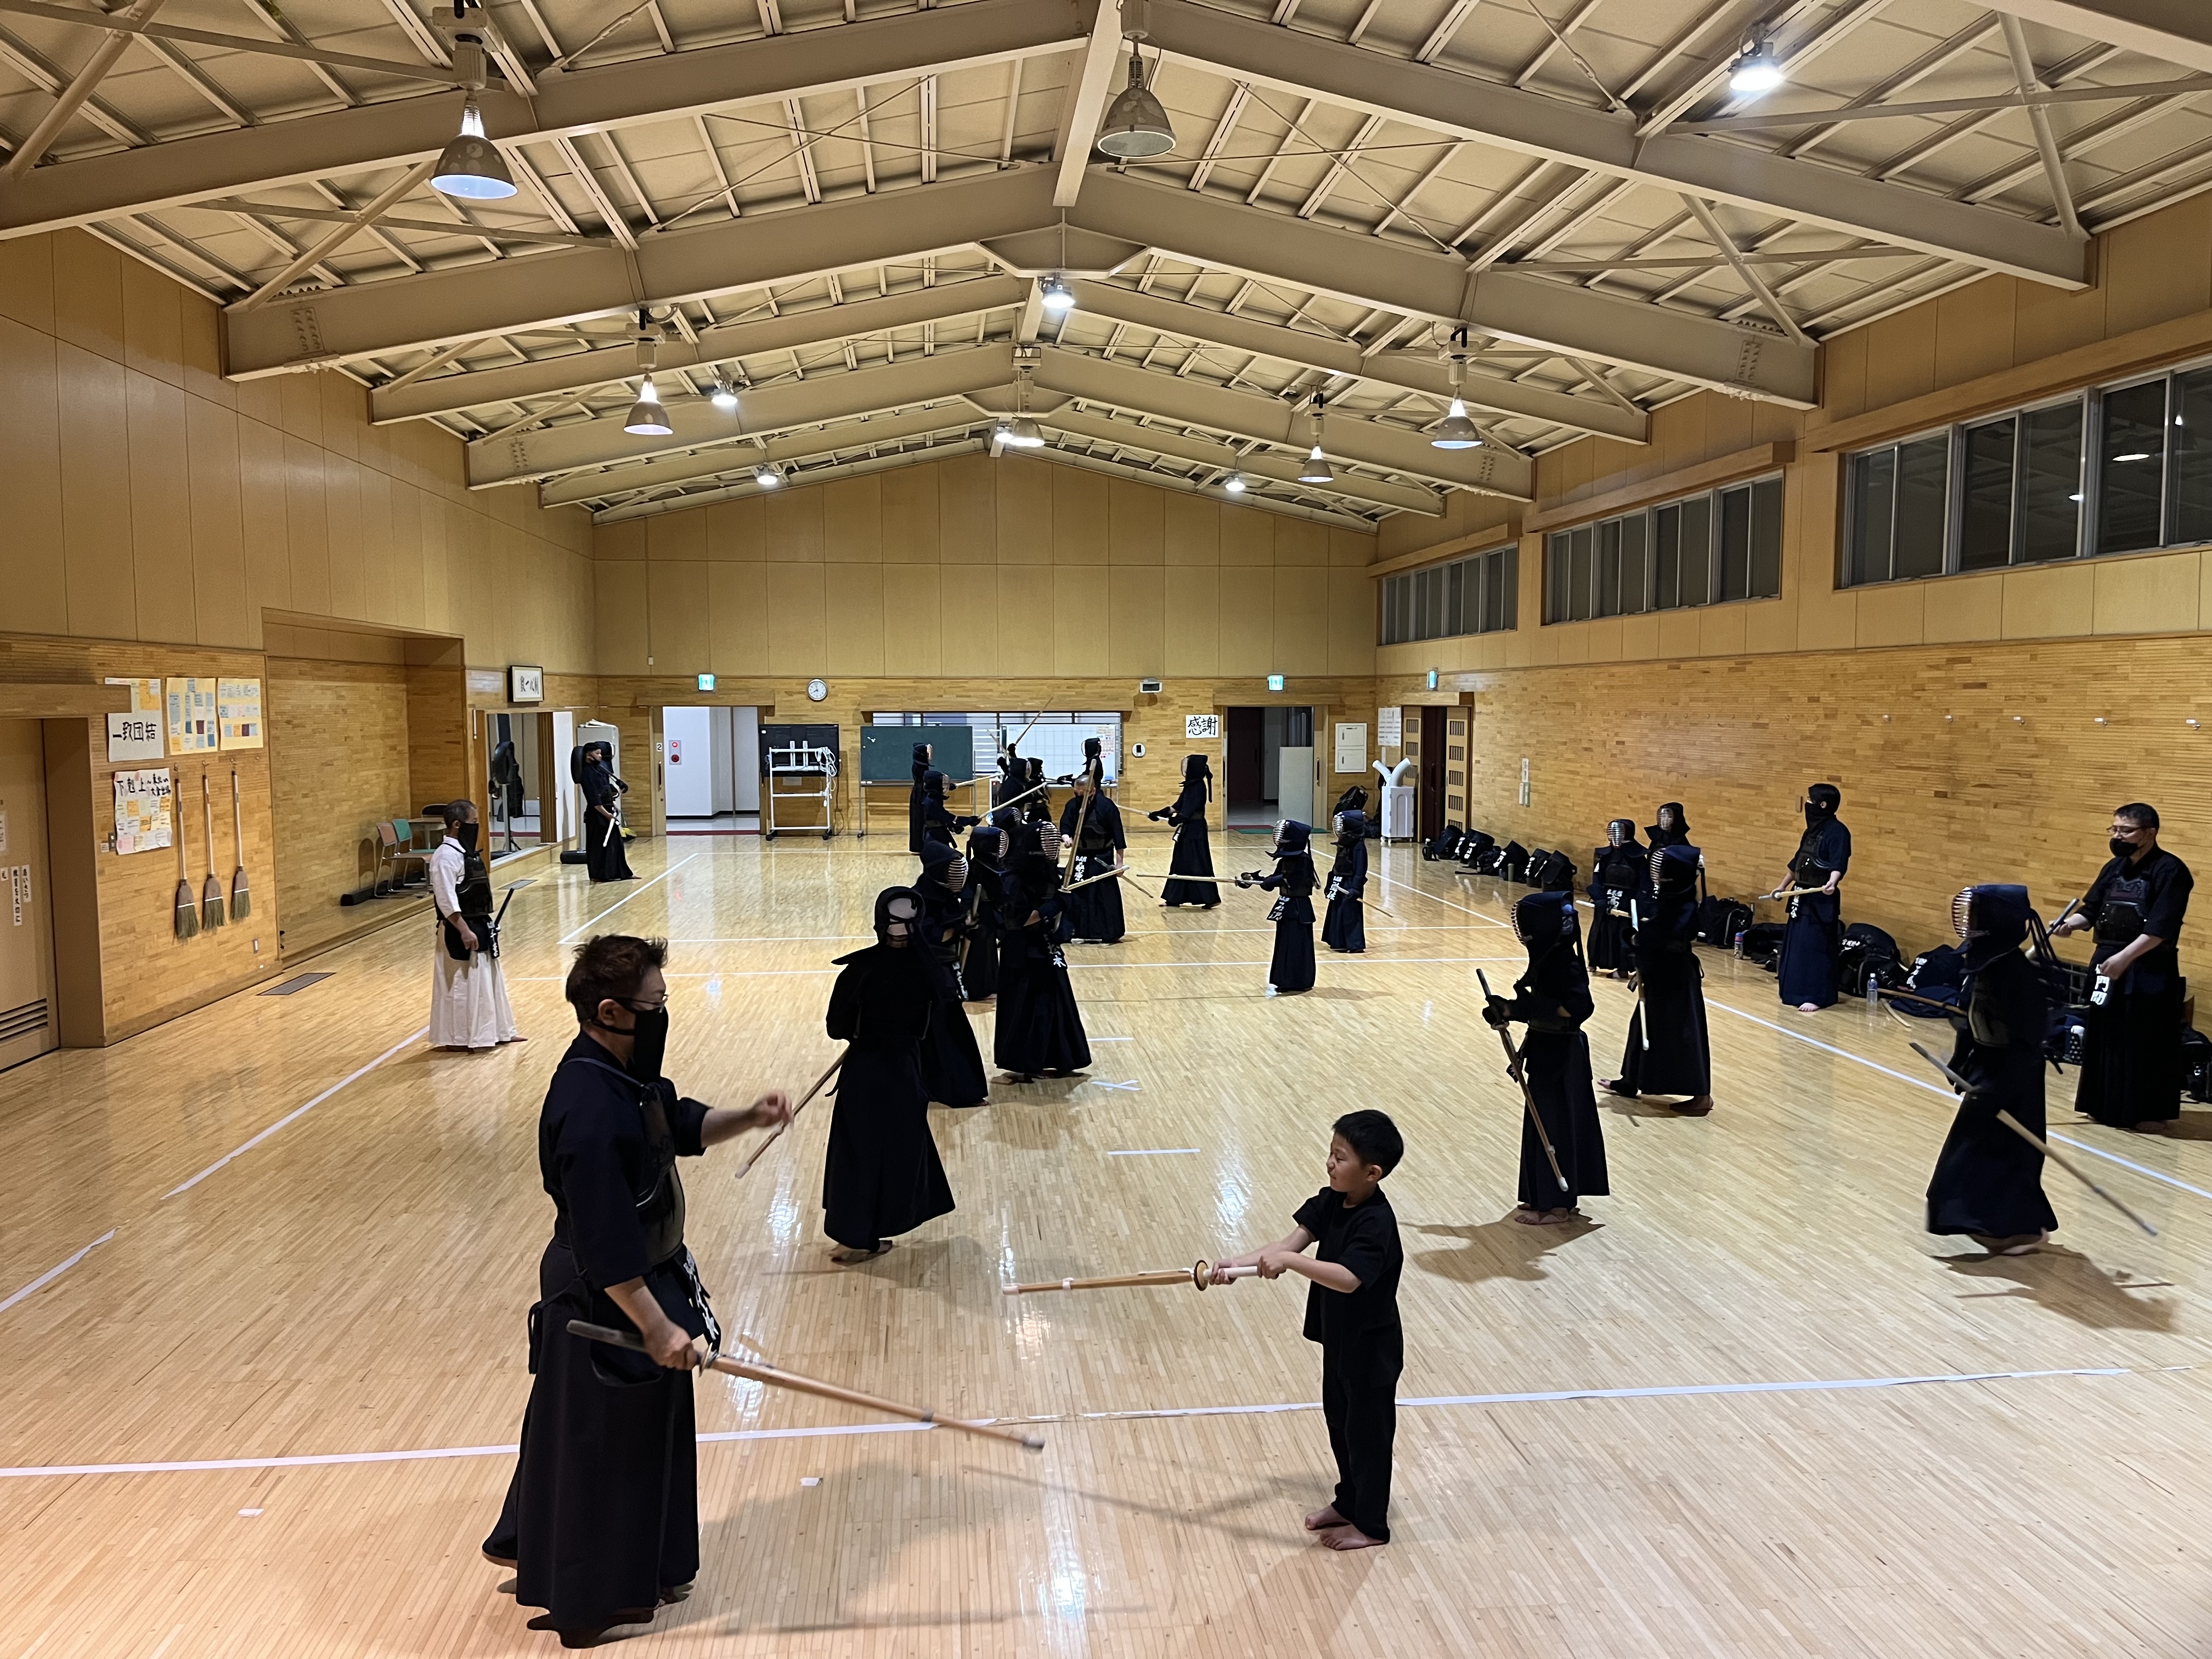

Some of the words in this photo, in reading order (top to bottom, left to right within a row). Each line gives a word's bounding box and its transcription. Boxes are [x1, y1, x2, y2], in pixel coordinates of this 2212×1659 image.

[112, 721, 157, 742] 一致団結
[1187, 715, 1218, 736] 感謝
[1047, 942, 1066, 968] 松本
